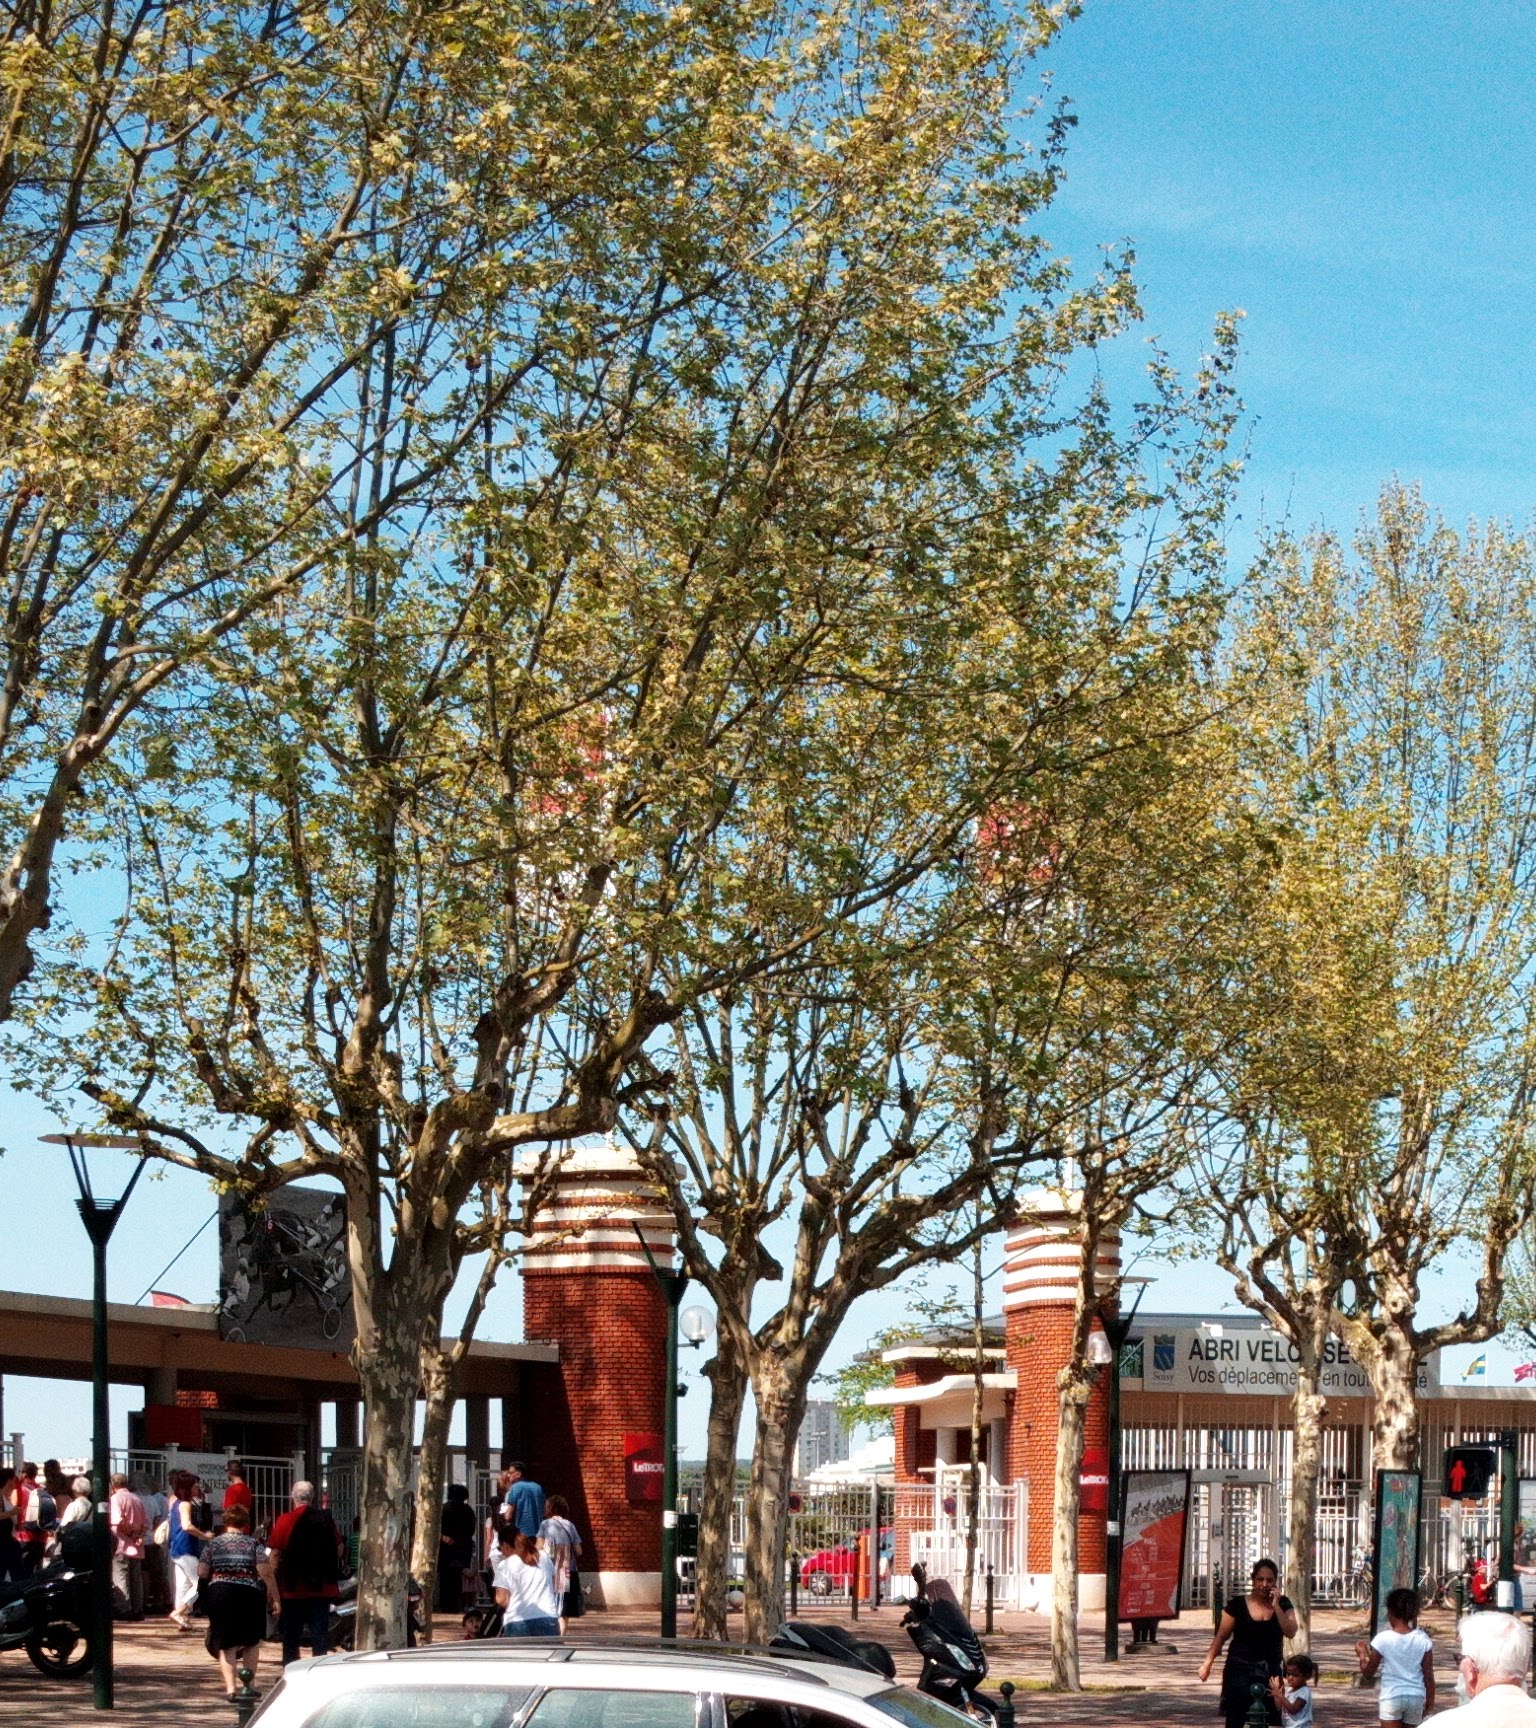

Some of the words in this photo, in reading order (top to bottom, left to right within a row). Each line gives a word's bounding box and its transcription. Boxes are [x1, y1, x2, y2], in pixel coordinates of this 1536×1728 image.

[1188, 1338, 1239, 1361] ABRI
[1188, 1365, 1216, 1384] Vos
[1219, 1366, 1298, 1386] déplaceme
[1322, 1373, 1341, 1387] en
